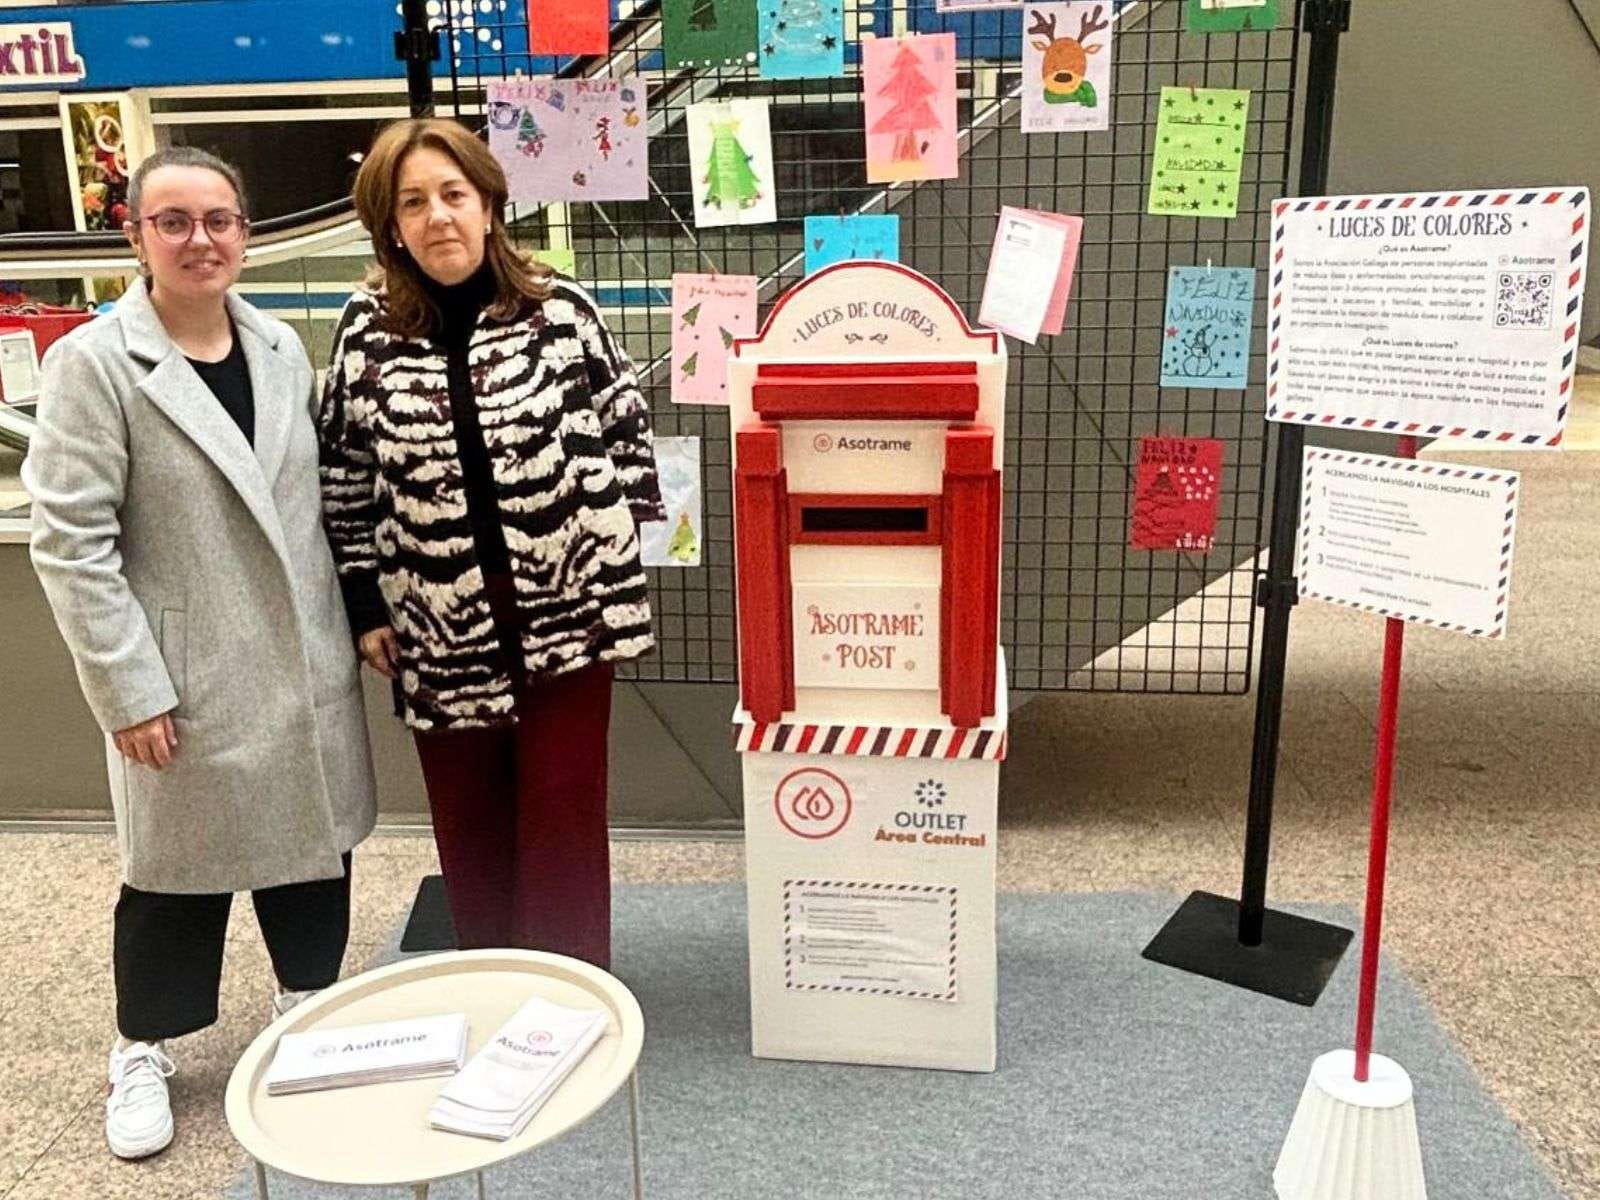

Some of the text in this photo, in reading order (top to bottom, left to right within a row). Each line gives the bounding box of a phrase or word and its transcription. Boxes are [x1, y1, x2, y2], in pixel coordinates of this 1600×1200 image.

[1330, 212, 1513, 237] LUCES DE COLORES
[1512, 255, 1555, 265] Asotrame
[796, 301, 938, 341] LUCES DE COLORES
[838, 437, 912, 451] Asotrame
[1325, 468, 1368, 482] ACERCAMOS
[1370, 474, 1378, 482] LA
[1380, 476, 1415, 488] NAVIDAD
[1423, 483, 1439, 491] LOS
[1441, 485, 1490, 498] HOSPITALES
[811, 613, 923, 636] ASOTRAME
[836, 643, 897, 669] POST
[895, 811, 967, 830] OUTLET
[874, 824, 986, 847] Área Central
[342, 1033, 427, 1053] Asotrame
[496, 1036, 561, 1057] Asotrame
